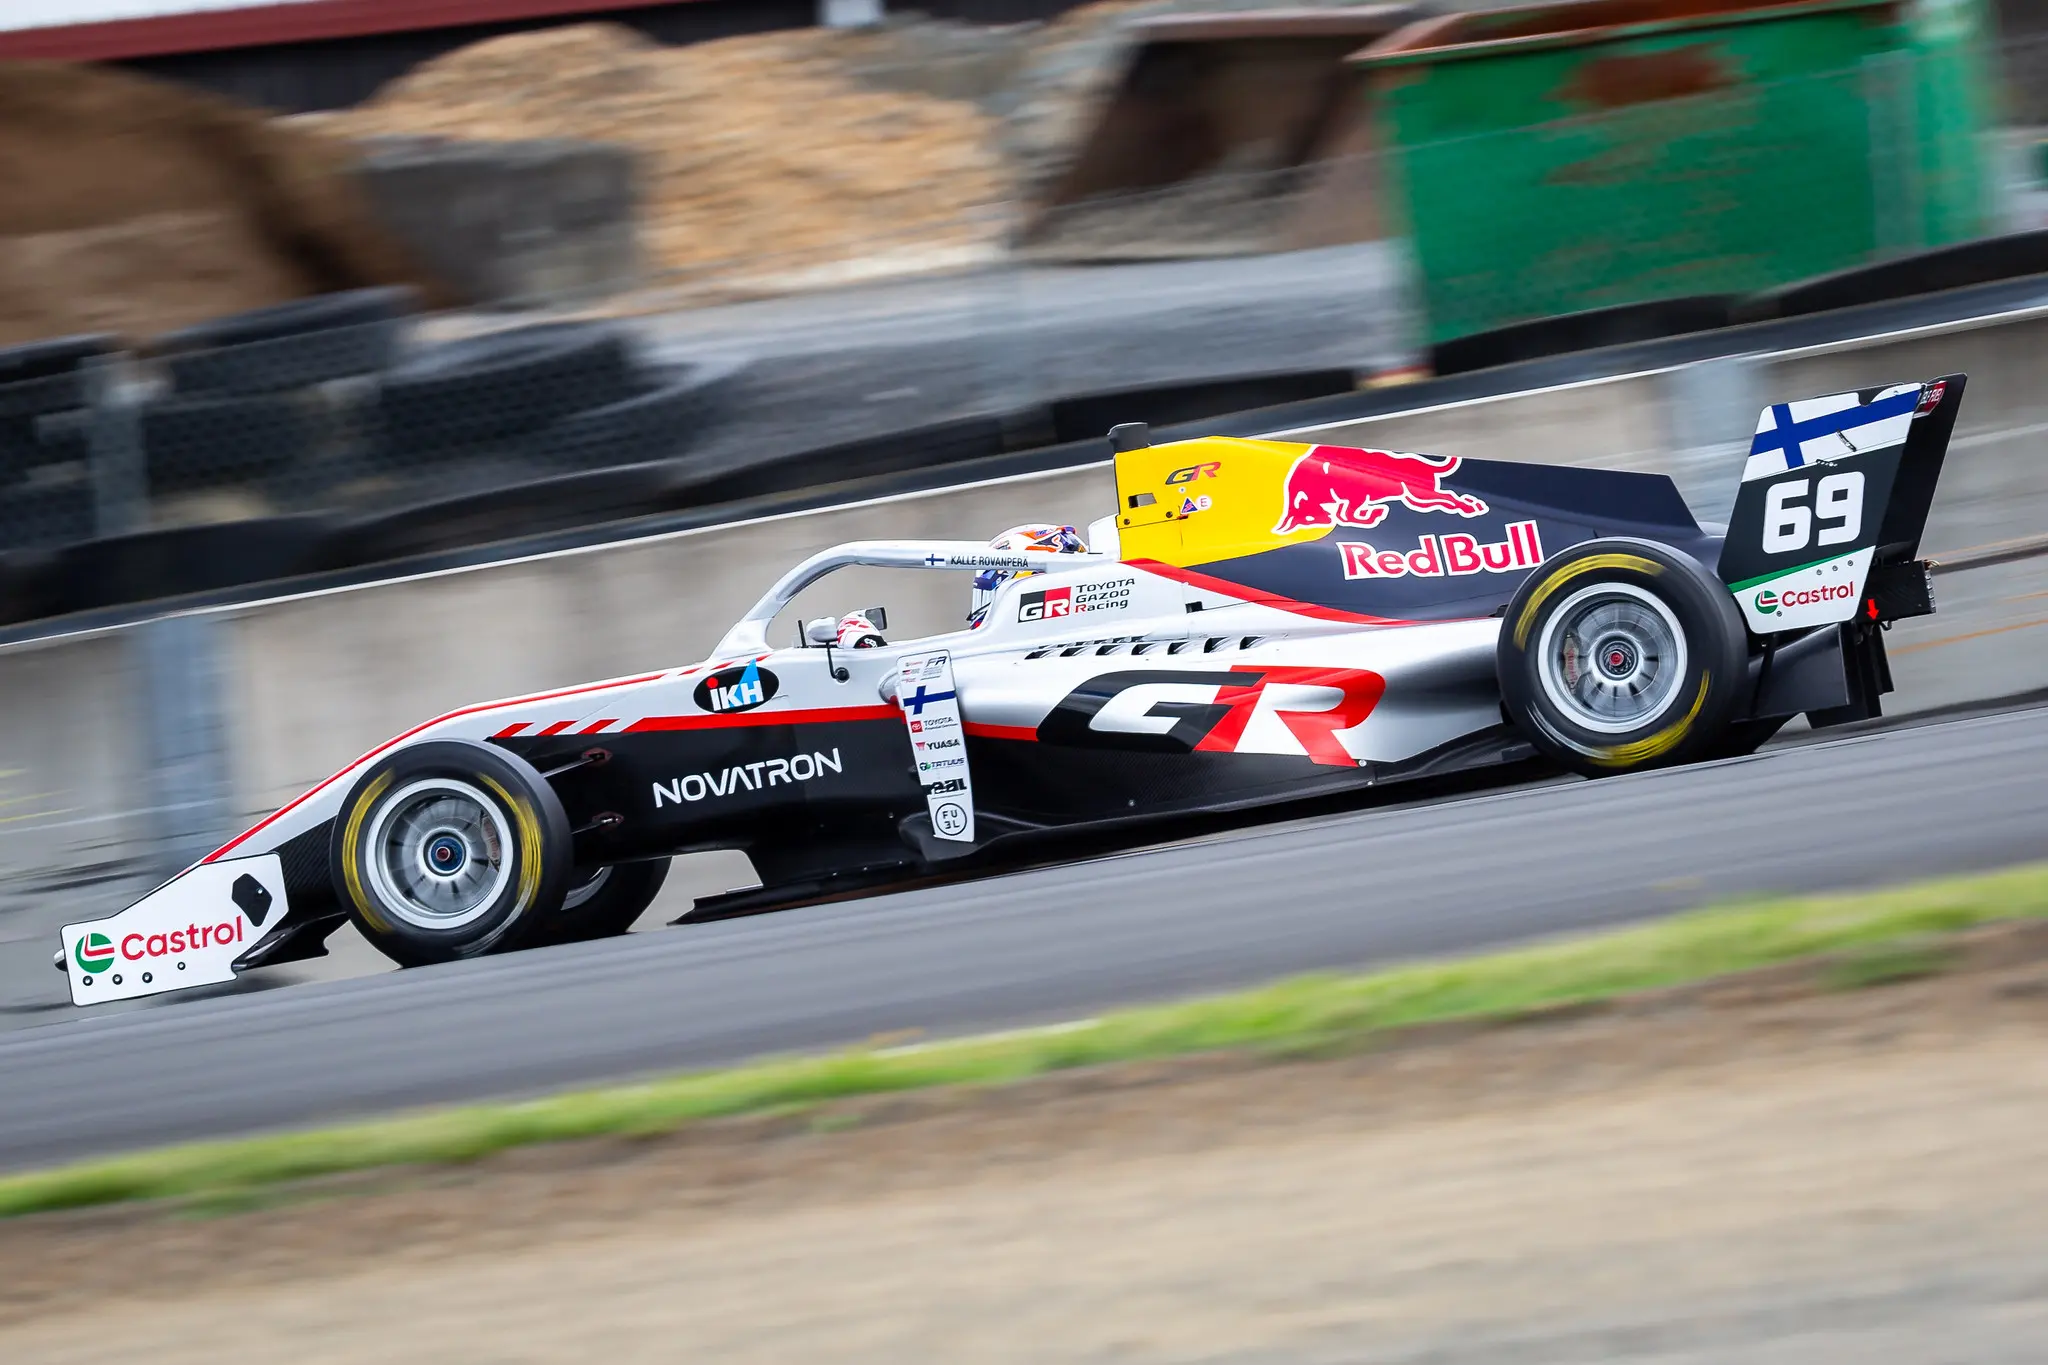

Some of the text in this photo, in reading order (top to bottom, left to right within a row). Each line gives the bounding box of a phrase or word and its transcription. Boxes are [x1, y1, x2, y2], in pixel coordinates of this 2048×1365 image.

[1165, 461, 1222, 485] GR
[1762, 471, 1866, 554] 69
[950, 555, 976, 566] KALLE
[1337, 521, 1542, 579] Red Bull
[1075, 578, 1136, 594] TOYOTA
[1075, 588, 1130, 604] GAZOO
[1781, 580, 1855, 608] Castrol
[1018, 598, 1070, 621] GR
[1074, 599, 1129, 614] Racing
[1036, 665, 1386, 768] GR
[926, 739, 961, 751] YUASA
[652, 747, 843, 809] NOVATRON
[121, 914, 244, 961] Castrol
